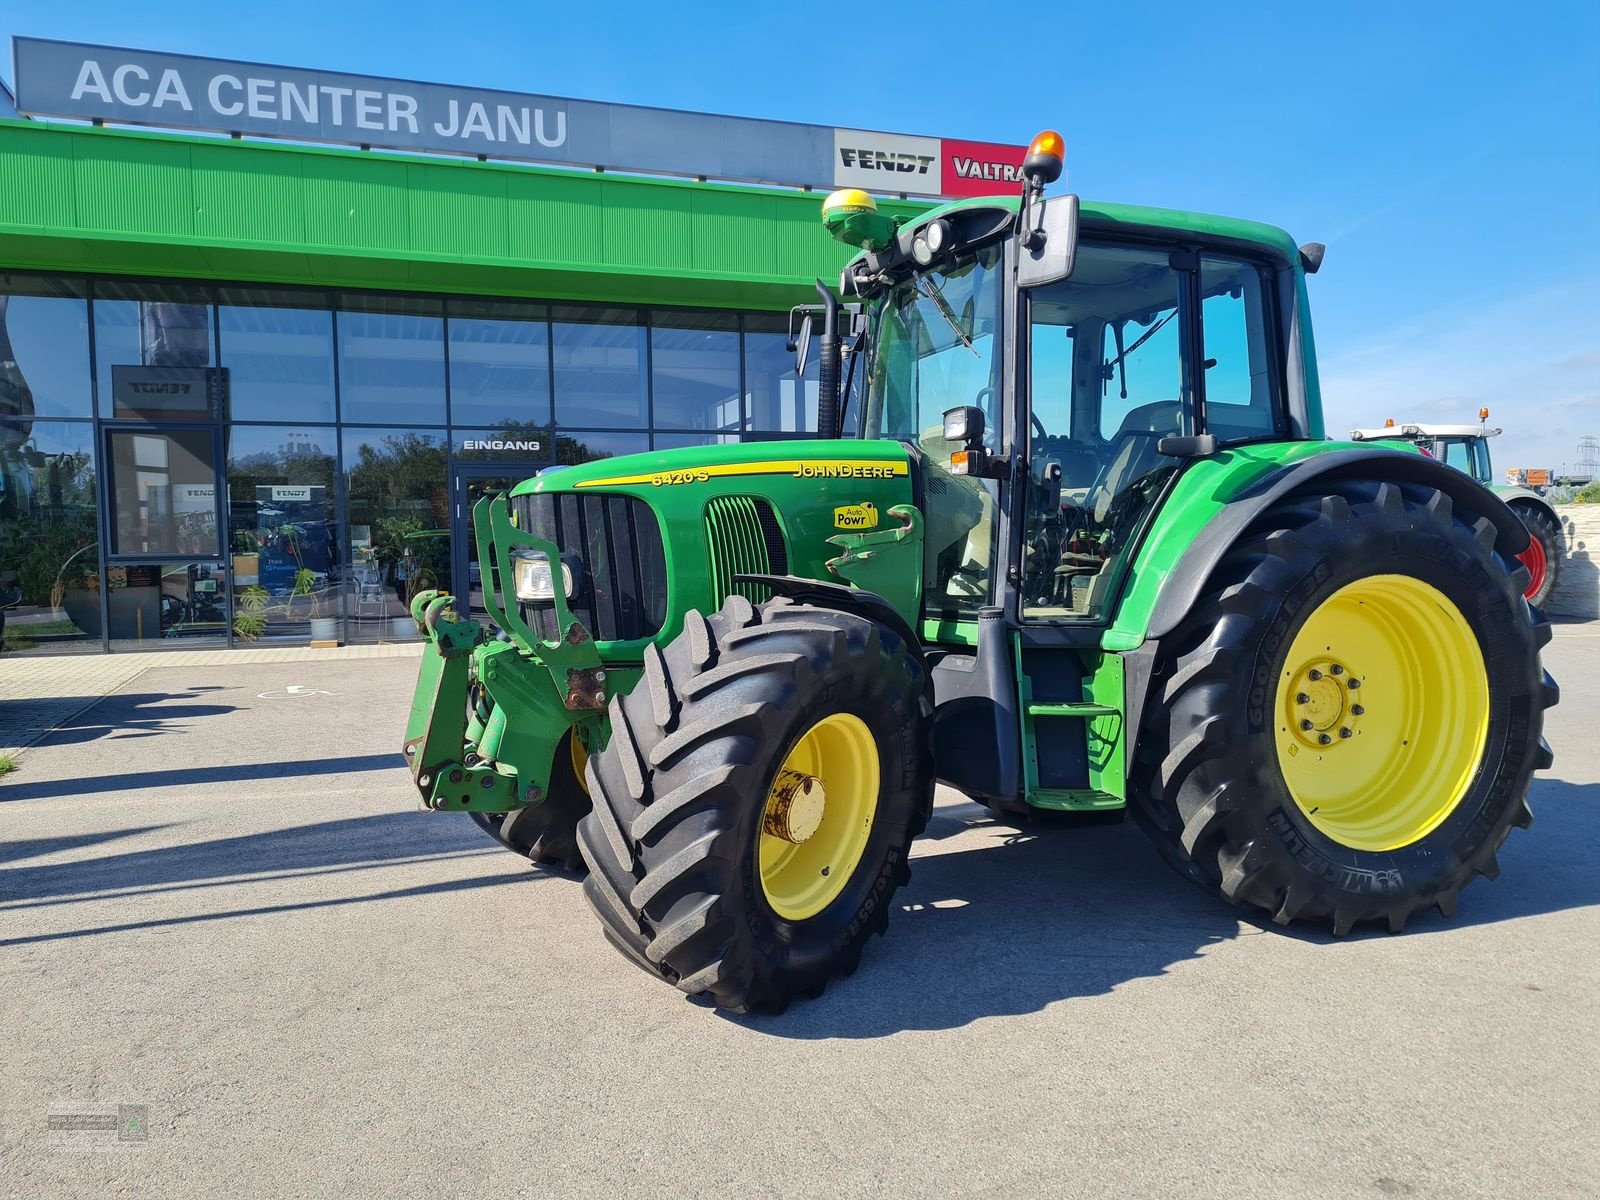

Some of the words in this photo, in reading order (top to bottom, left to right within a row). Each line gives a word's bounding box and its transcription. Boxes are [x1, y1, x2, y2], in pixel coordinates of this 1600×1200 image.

[70, 60, 193, 111] ACA
[207, 74, 419, 134] CENTER
[433, 100, 567, 148] JANU
[840, 148, 935, 174] FENDT
[463, 440, 540, 451] EINGANG
[793, 464, 838, 478] JOHN
[839, 463, 895, 478] DEERE
[837, 513, 866, 526] Powr
[846, 508, 863, 517] Auto
